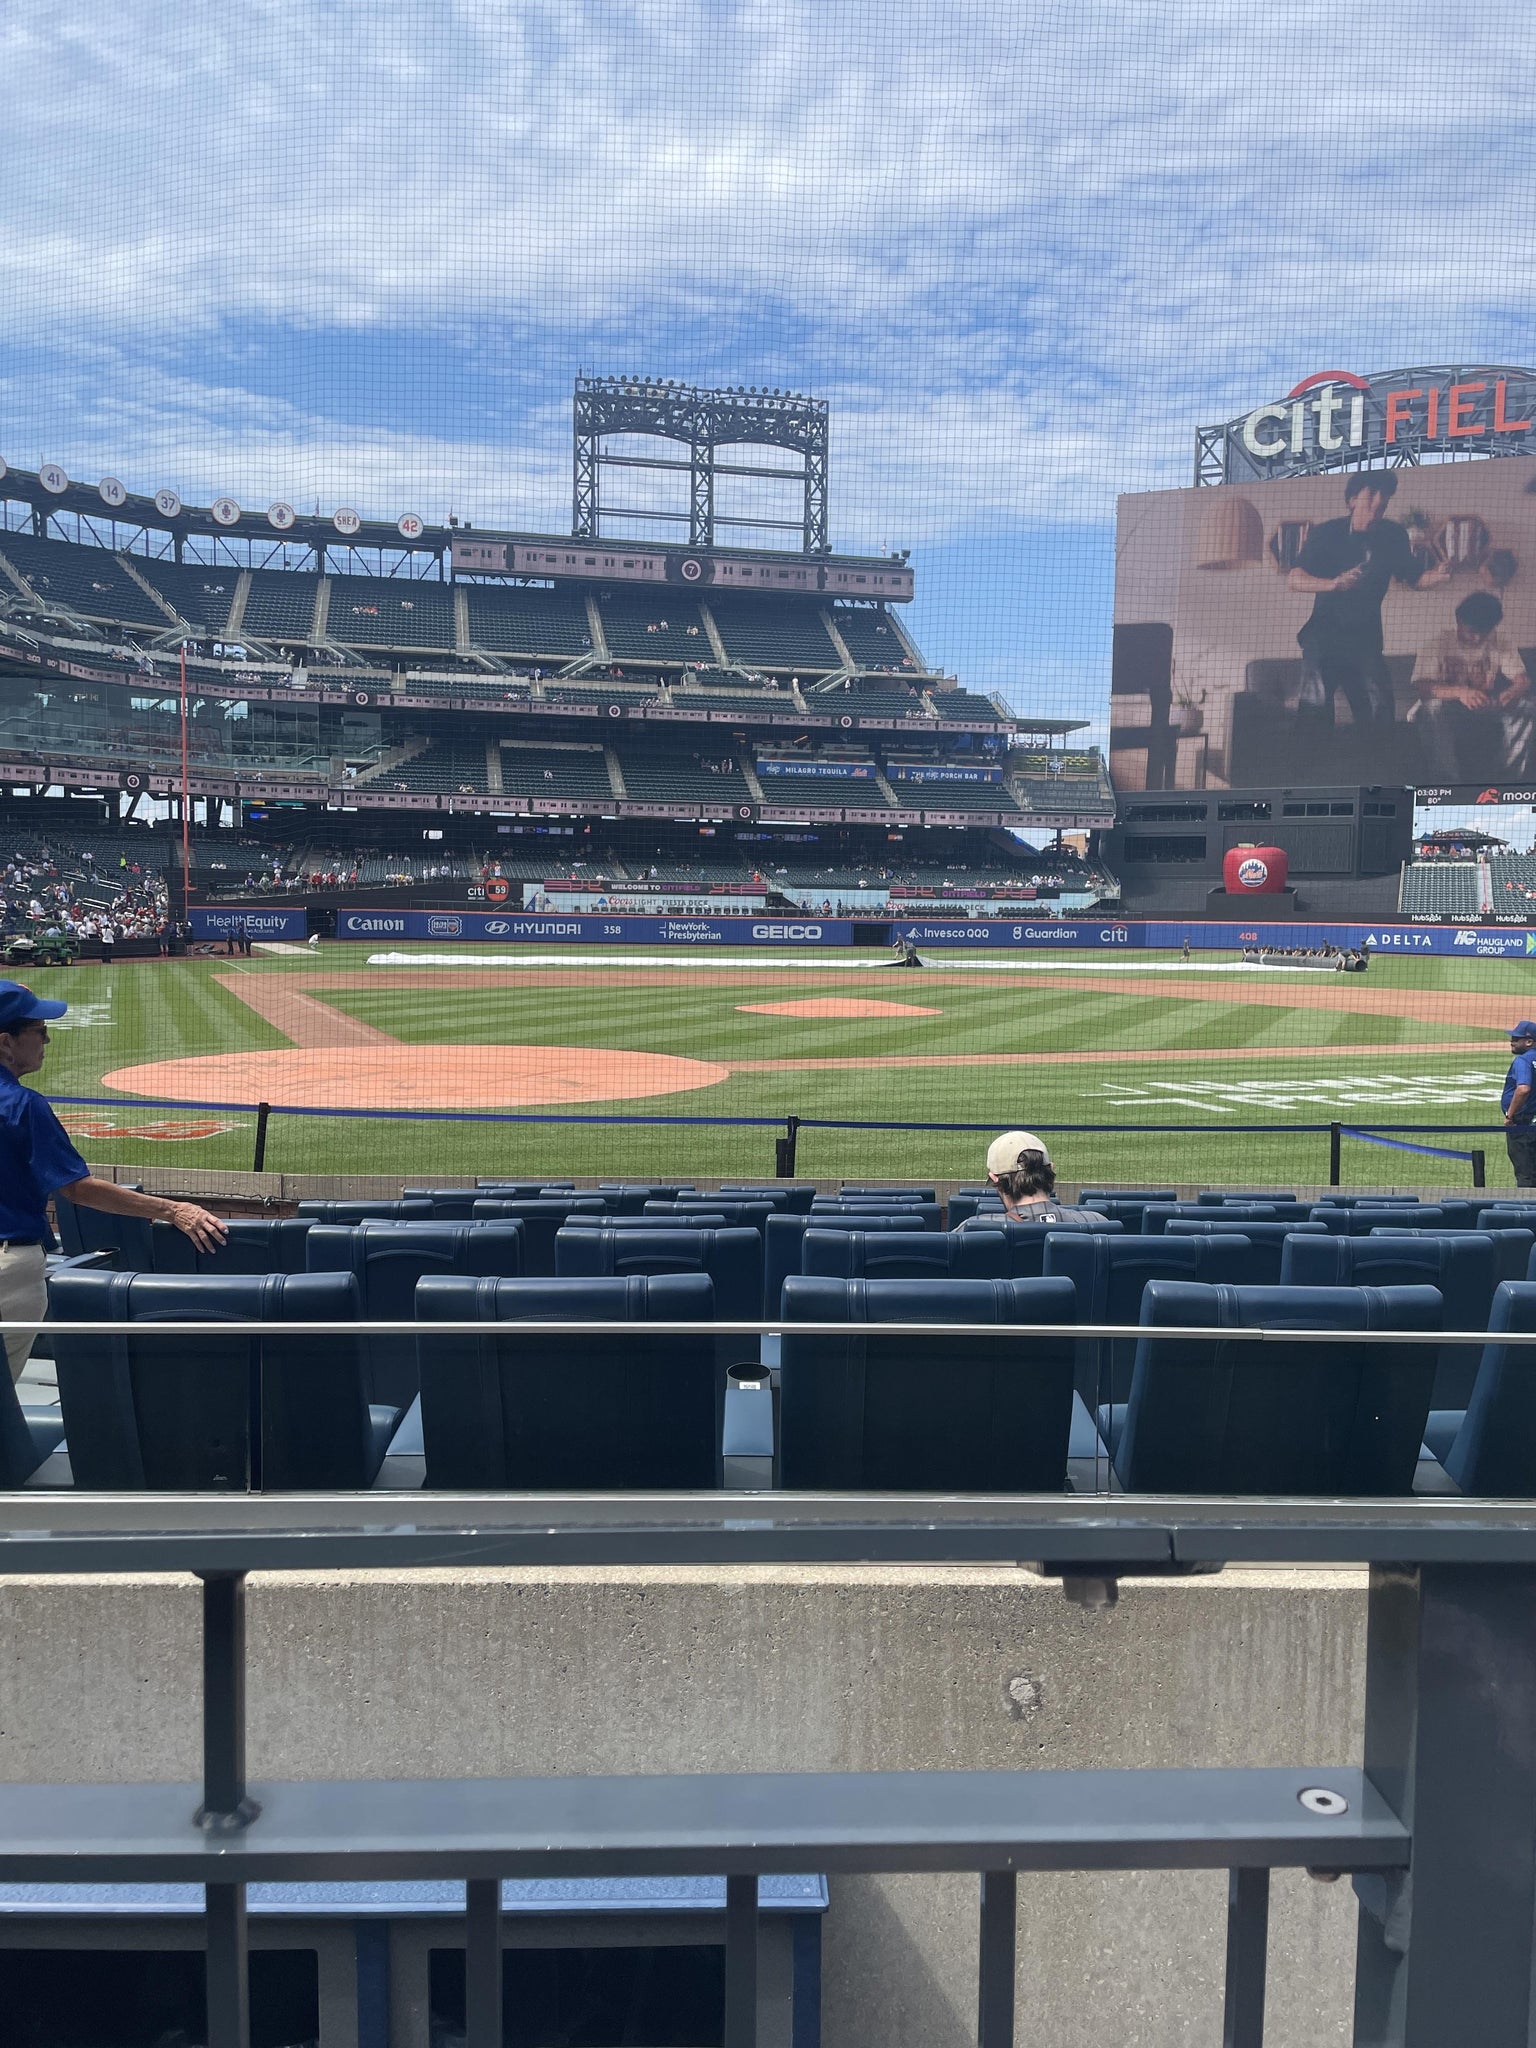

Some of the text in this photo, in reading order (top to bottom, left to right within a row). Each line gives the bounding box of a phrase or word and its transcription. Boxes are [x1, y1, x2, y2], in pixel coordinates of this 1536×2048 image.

[1243, 384, 1365, 457] citi
[47, 472, 61, 487] 41
[106, 484, 119, 499] 14
[161, 496, 176, 510] 37
[336, 515, 357, 527] SHEA
[402, 519, 418, 533] 42
[467, 886, 485, 896] citi
[495, 886, 506, 894] 59
[611, 883, 649, 891] WELCOME
[608, 895, 633, 905] Coors
[206, 914, 287, 930] HealthEquity
[347, 916, 405, 931] Canon
[1411, 914, 1442, 923] HubSpot
[1451, 914, 1483, 923] HubSpot
[1495, 914, 1528, 924] HubSpot
[513, 922, 582, 935] HYUNDAI
[603, 925, 622, 934] 358
[668, 921, 710, 931] NewYork-
[752, 924, 822, 940] GEICO
[668, 930, 722, 942] Presbyterian
[924, 927, 990, 939] Invesco QQQ
[1025, 927, 1078, 939] Guardian
[1100, 926, 1128, 942] citi
[1239, 932, 1258, 941] 408
[1381, 933, 1432, 946] DELTA
[1476, 937, 1523, 947] HAUGLAND
[1476, 946, 1506, 955] GROUP
